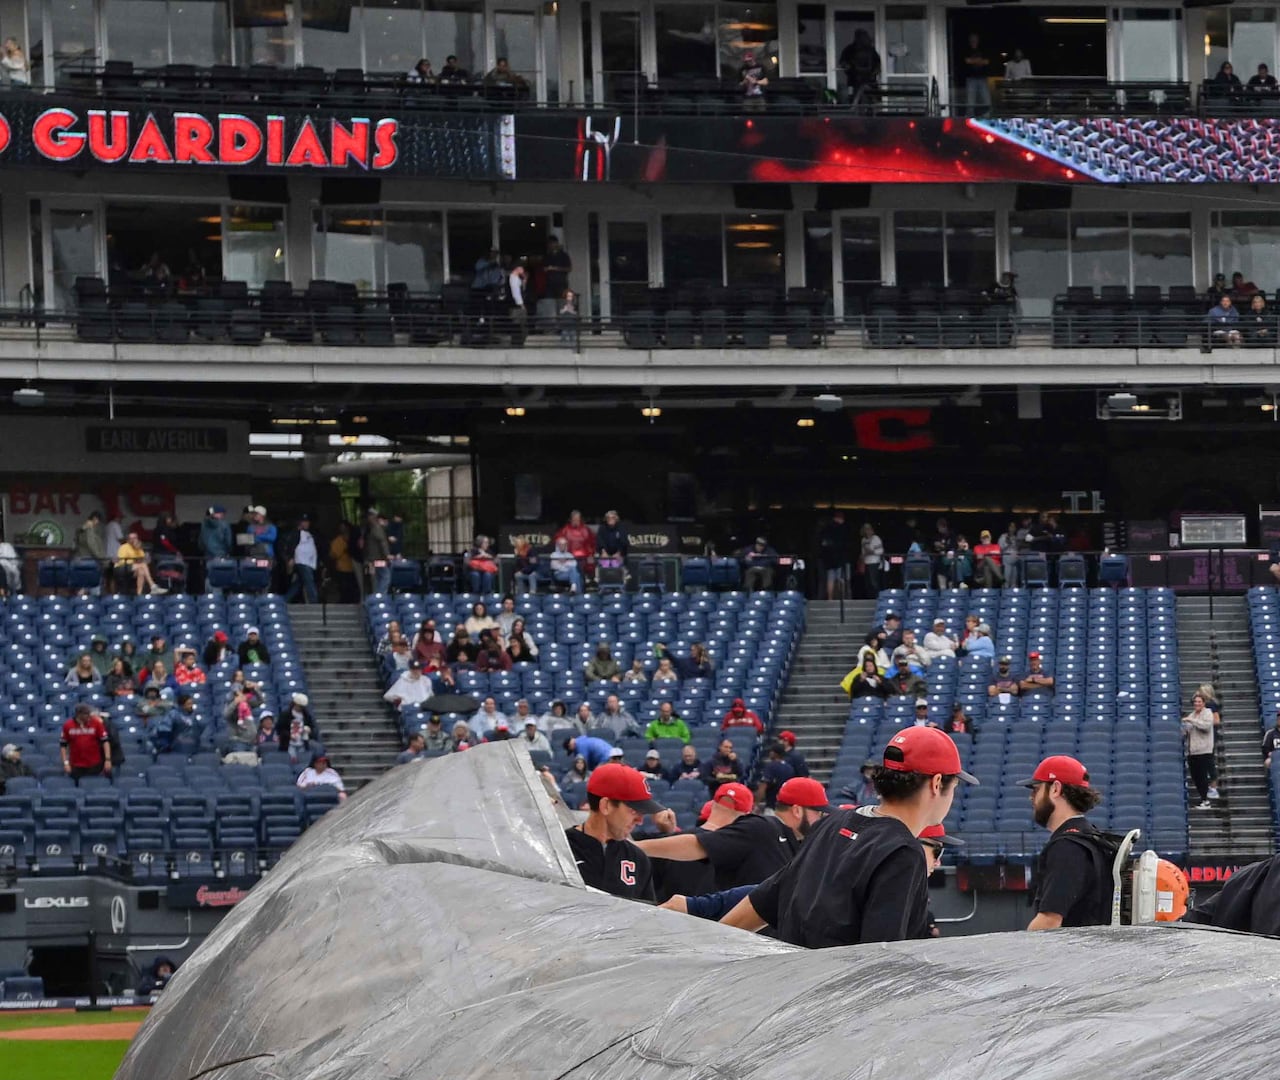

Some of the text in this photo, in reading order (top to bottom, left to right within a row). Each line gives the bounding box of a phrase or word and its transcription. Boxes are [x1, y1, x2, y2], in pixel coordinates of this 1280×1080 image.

[32, 107, 398, 170] GUARDIANS
[101, 429, 213, 450] EARL AVERILL
[855, 408, 933, 451] C
[10, 482, 80, 514] BAR
[621, 860, 636, 885] C
[24, 897, 89, 908] LEXUS
